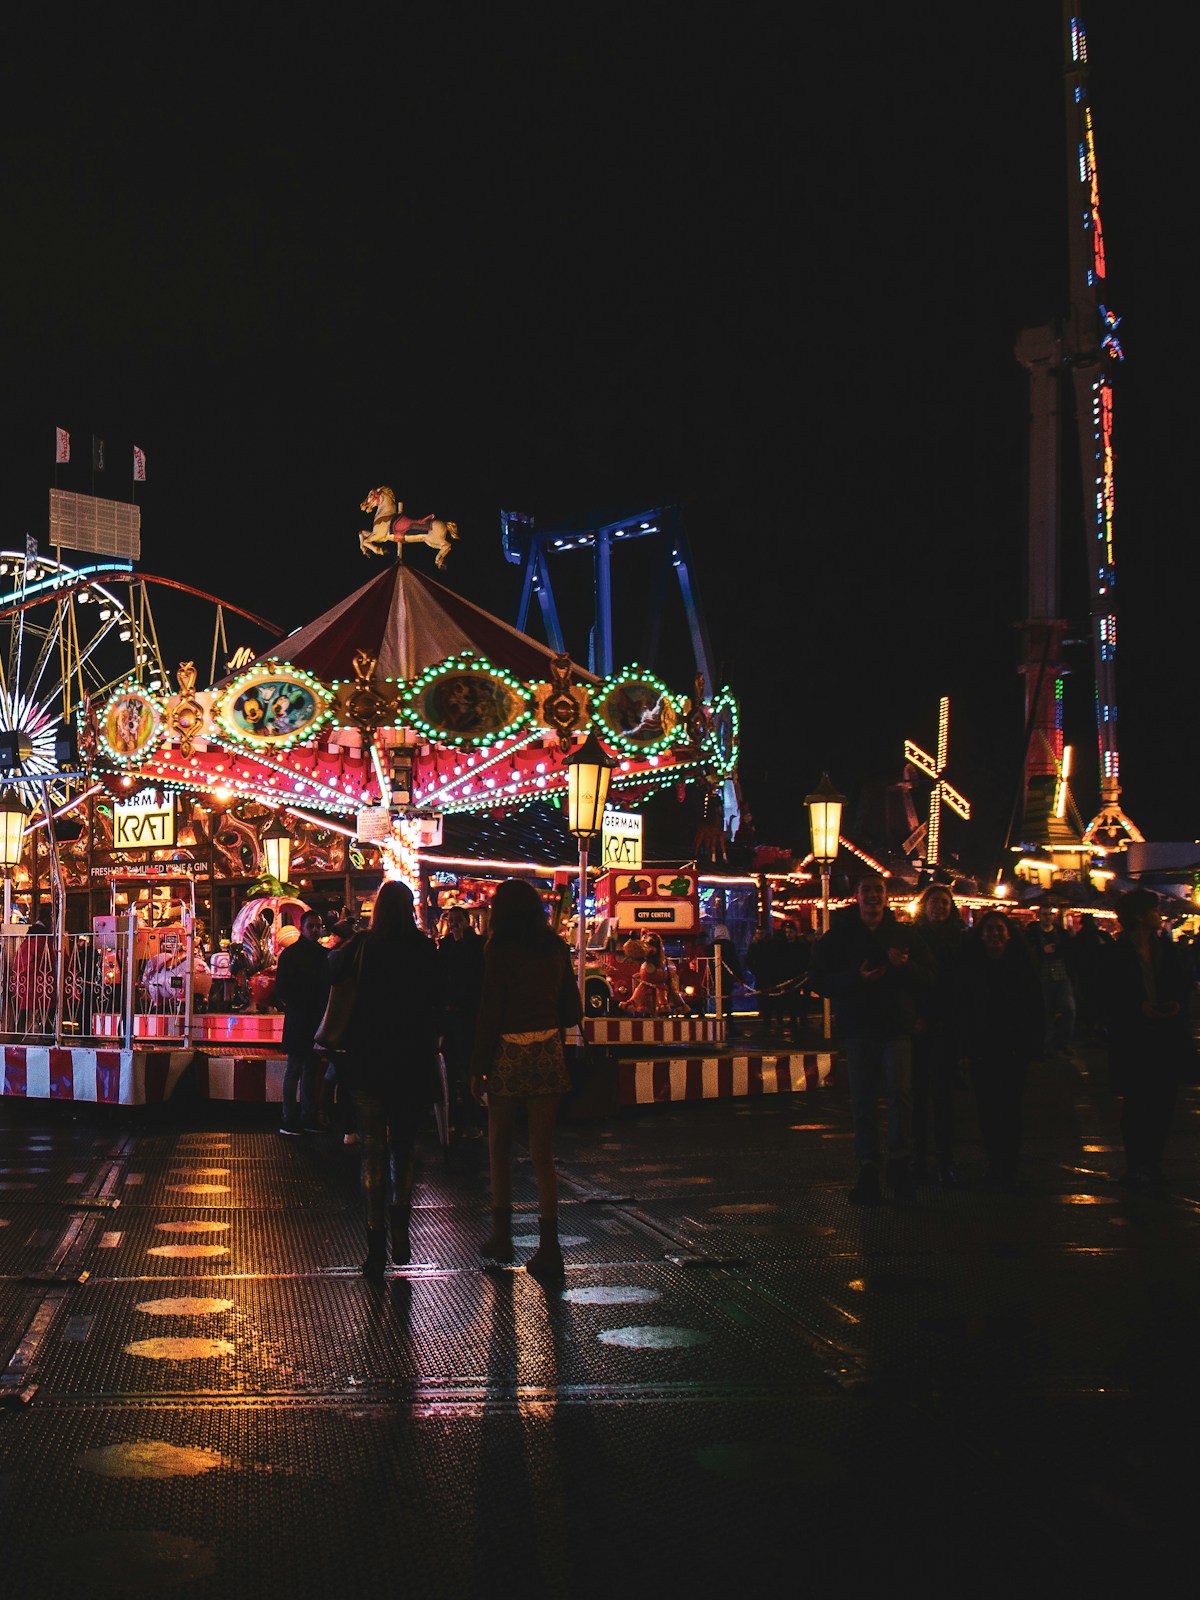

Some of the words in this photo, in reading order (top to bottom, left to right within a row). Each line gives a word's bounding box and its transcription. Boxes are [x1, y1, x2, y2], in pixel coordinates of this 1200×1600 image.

[118, 812, 170, 842] KRAFT
[604, 816, 639, 830] GERMAN
[604, 835, 639, 864] KRAFT
[91, 867, 112, 876] FRESH
[194, 862, 208, 871] GIN
